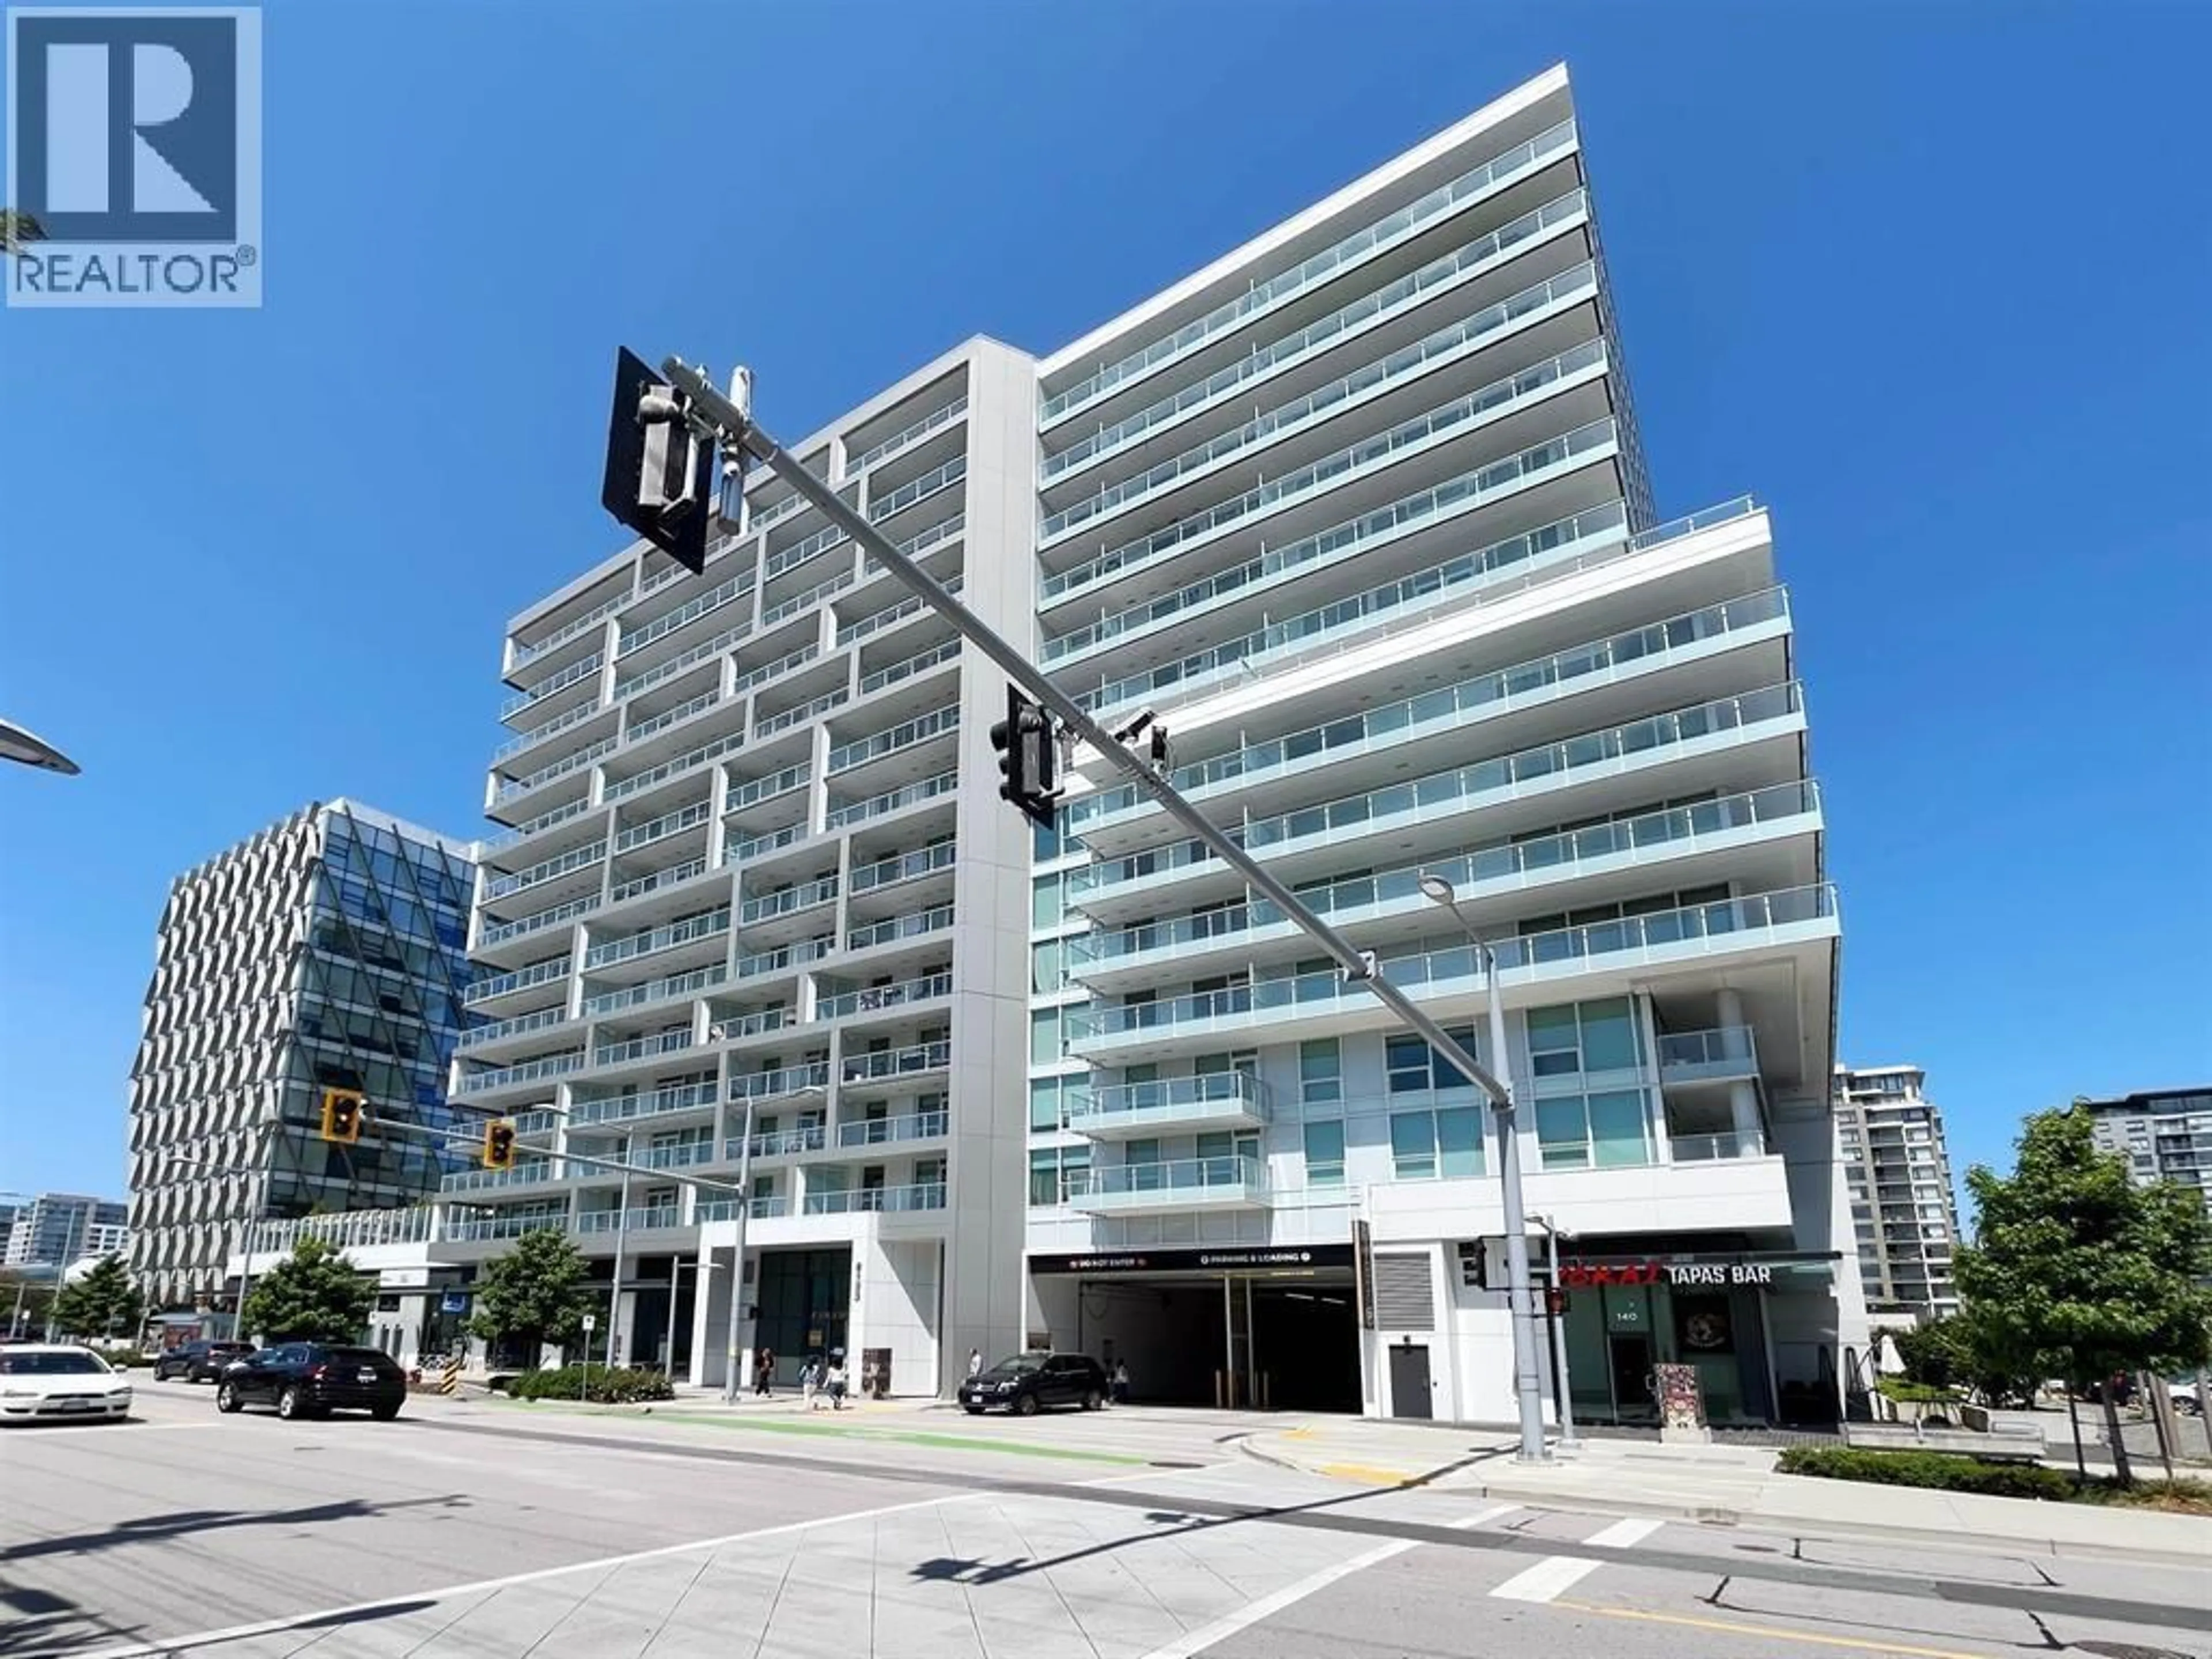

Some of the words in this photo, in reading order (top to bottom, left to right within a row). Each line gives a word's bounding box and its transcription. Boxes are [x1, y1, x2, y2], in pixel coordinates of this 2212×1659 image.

[1671, 1267, 1725, 1284] TAPAS
[1732, 1266, 1771, 1283] BAR
[1617, 1313, 1638, 1321] 140
